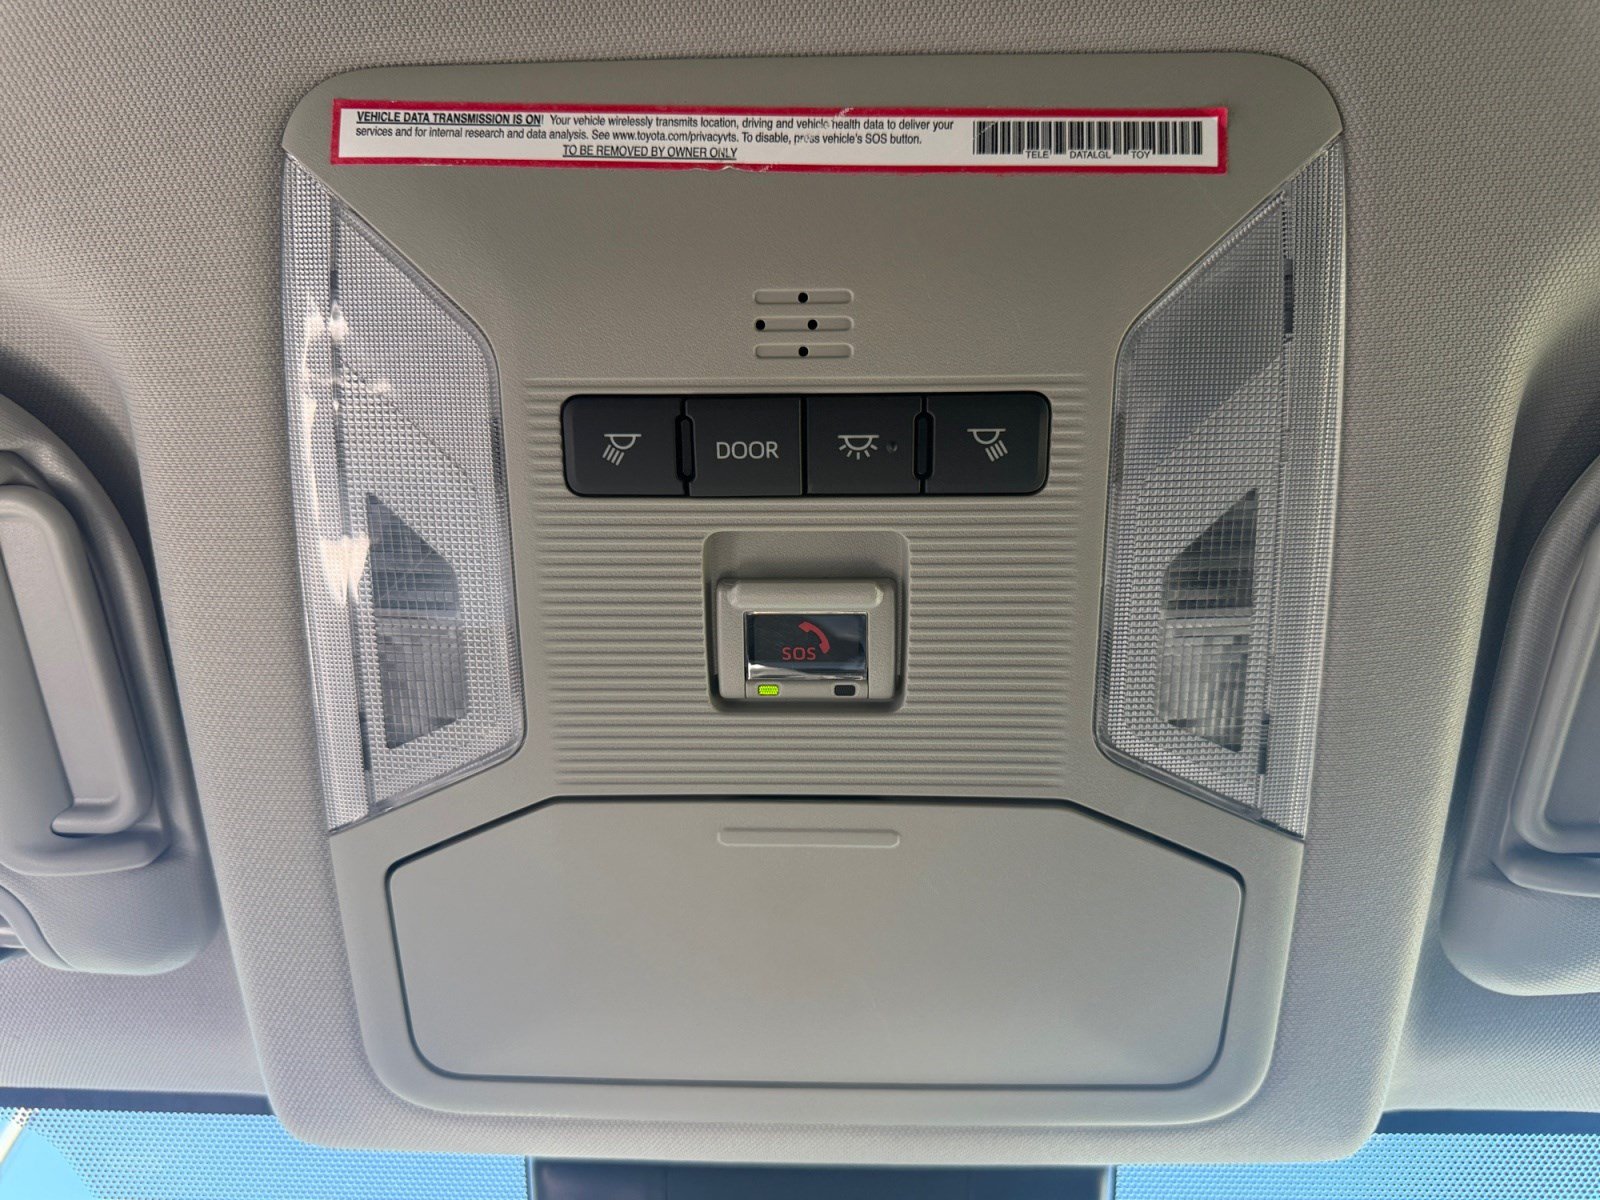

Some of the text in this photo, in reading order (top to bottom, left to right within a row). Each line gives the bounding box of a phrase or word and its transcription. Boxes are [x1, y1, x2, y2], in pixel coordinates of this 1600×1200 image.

[357, 112, 402, 123] VEHICLE
[404, 112, 431, 123] DATA
[433, 113, 510, 125] TRANSMISSION
[513, 114, 523, 125] IS
[525, 114, 544, 126] ON!
[550, 115, 571, 126] Your
[574, 115, 605, 126] vehicle
[608, 116, 653, 130] wirelessly
[656, 117, 698, 128] transmits
[700, 117, 739, 129] location,
[742, 117, 773, 131] driving
[776, 118, 793, 129] and
[832, 118, 860, 129] health
[863, 119, 884, 129] data
[887, 120, 896, 130] to
[899, 119, 930, 130] deliver
[933, 121, 953, 132] your
[356, 127, 393, 137] services
[395, 127, 413, 137] and
[415, 127, 427, 137] for
[429, 127, 462, 138] internal
[465, 128, 505, 139] research
[507, 128, 524, 139] and
[527, 129, 546, 139] data
[549, 129, 588, 141] analysis.
[591, 130, 610, 140] See
[613, 130, 738, 144] www.toyota.com/privacyvts.
[742, 132, 753, 143] To
[756, 132, 791, 144] disable,
[823, 133, 862, 144] vehicle's
[865, 133, 887, 144] SOS
[890, 134, 922, 144] button.
[563, 145, 737, 159] TO BE REMOVED BY OWNER ONLY
[1070, 151, 1111, 159] DATALGL
[716, 441, 779, 460] DOOR
[782, 646, 816, 662] SOS
